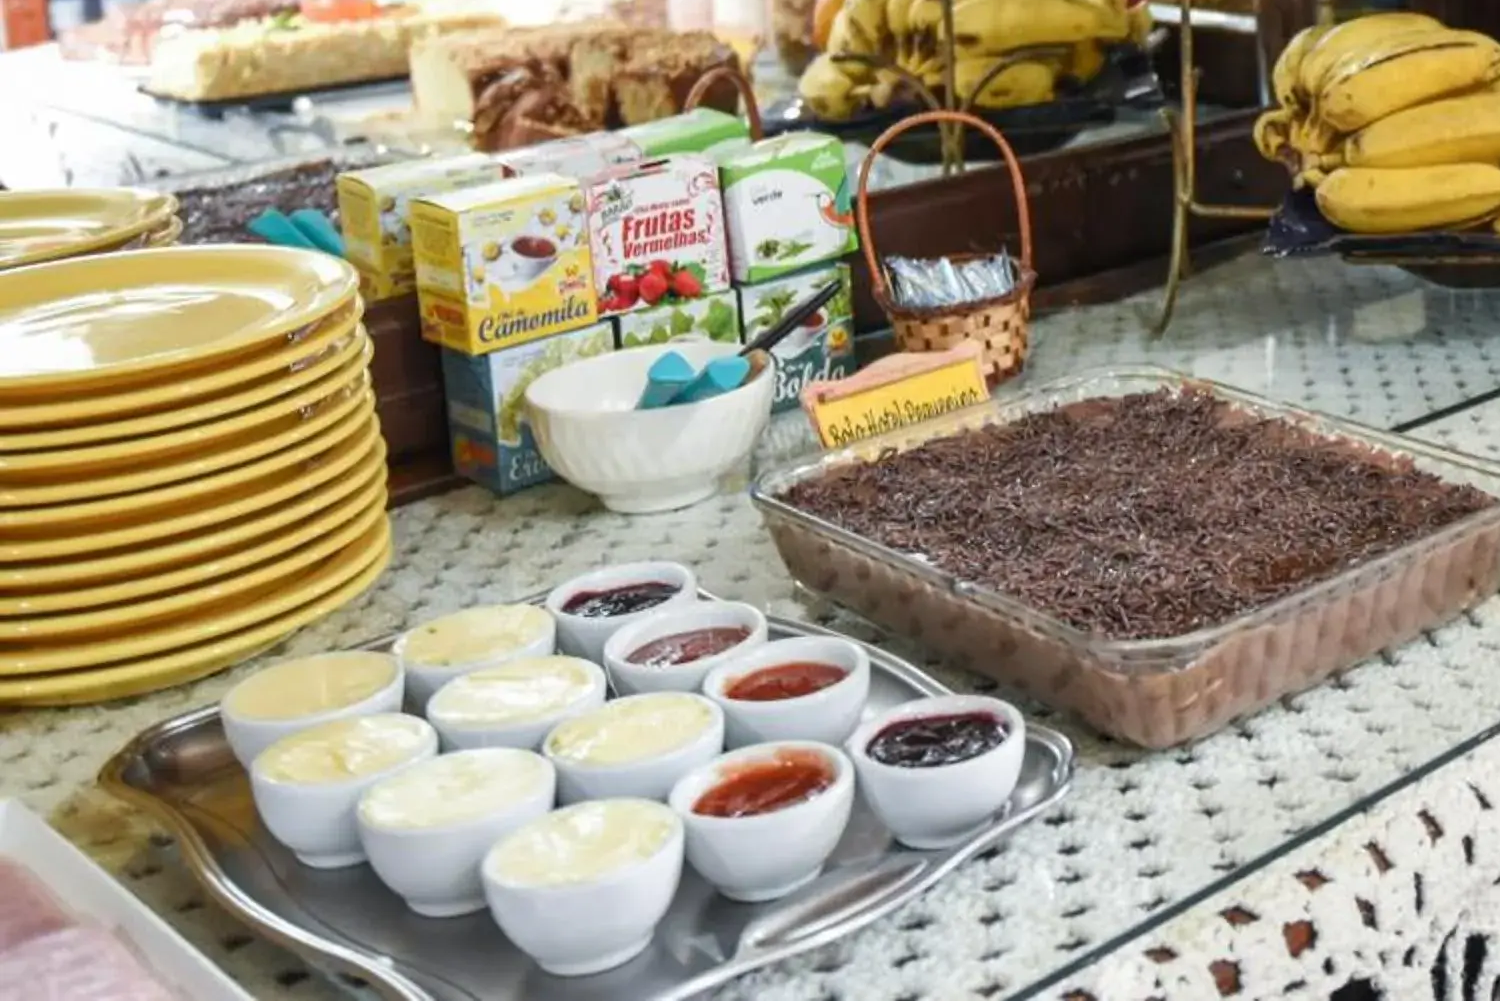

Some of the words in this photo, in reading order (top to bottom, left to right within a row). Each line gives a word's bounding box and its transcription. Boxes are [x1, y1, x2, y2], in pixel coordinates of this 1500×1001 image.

[622, 208, 695, 241] Frutas
[623, 229, 708, 259] Vermelhas
[478, 295, 590, 343] Camomila
